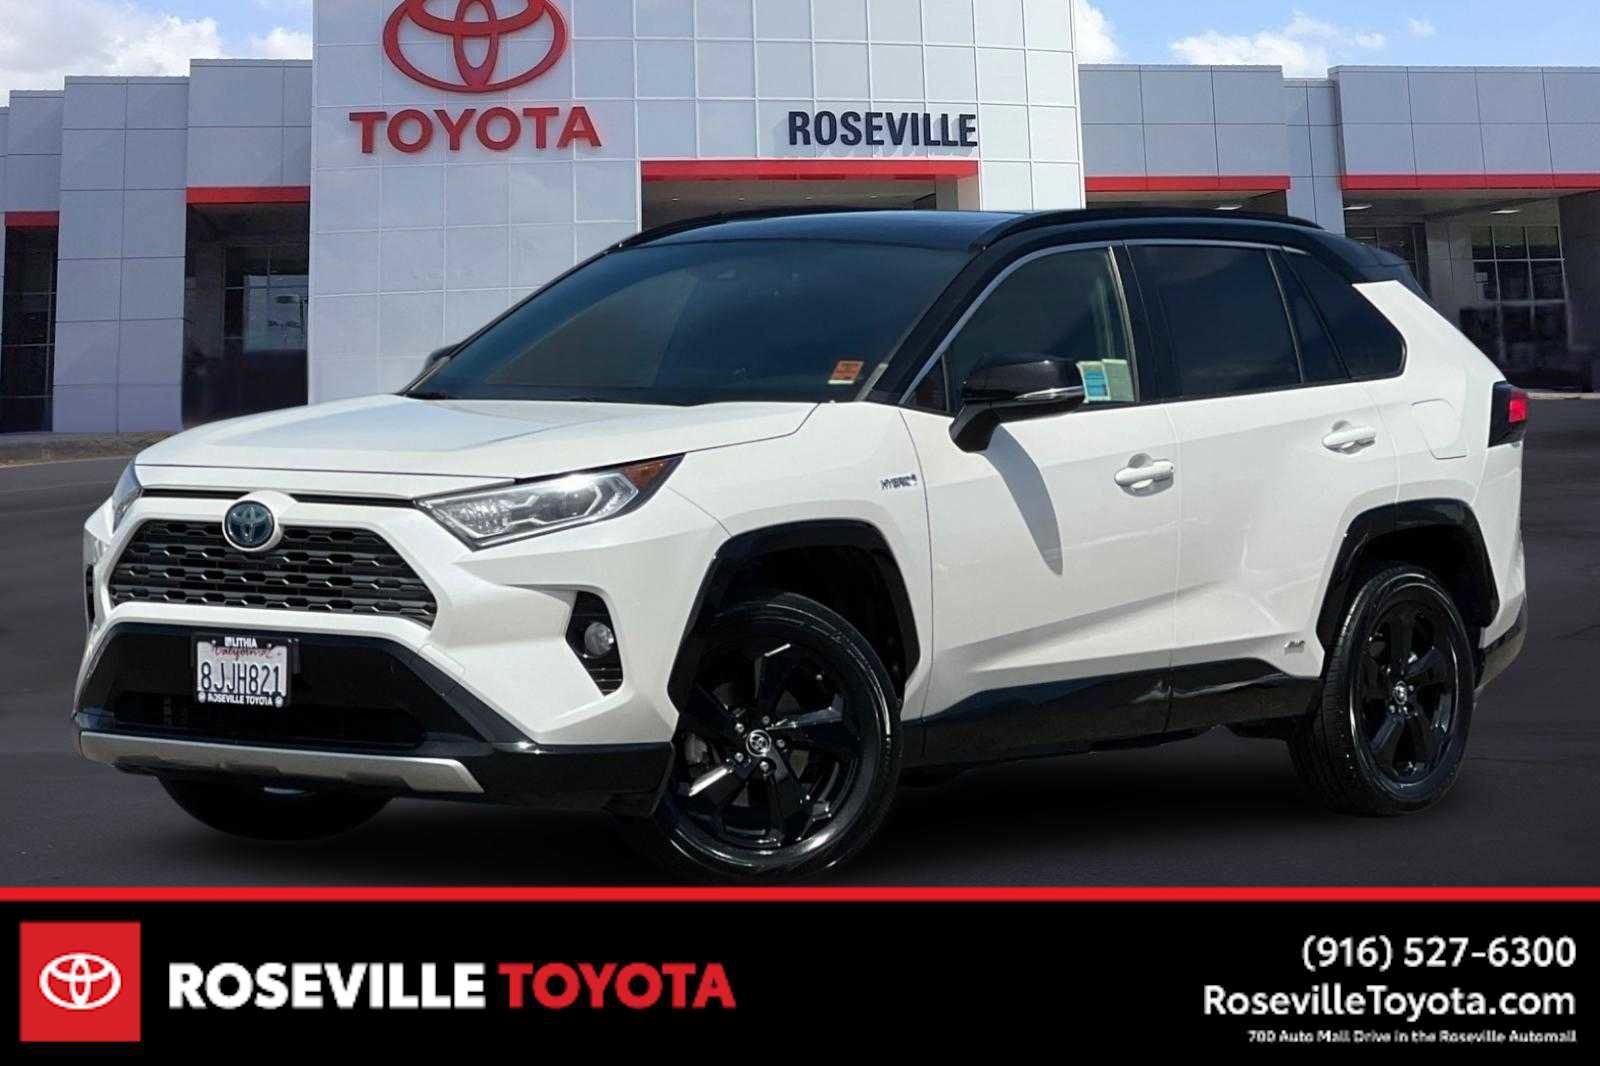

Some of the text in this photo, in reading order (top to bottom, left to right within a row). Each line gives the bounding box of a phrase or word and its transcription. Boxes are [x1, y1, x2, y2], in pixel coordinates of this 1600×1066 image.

[349, 106, 602, 154] TOYOTA
[789, 111, 978, 147] ROSEVILLE
[201, 661, 280, 696] 8JJH821
